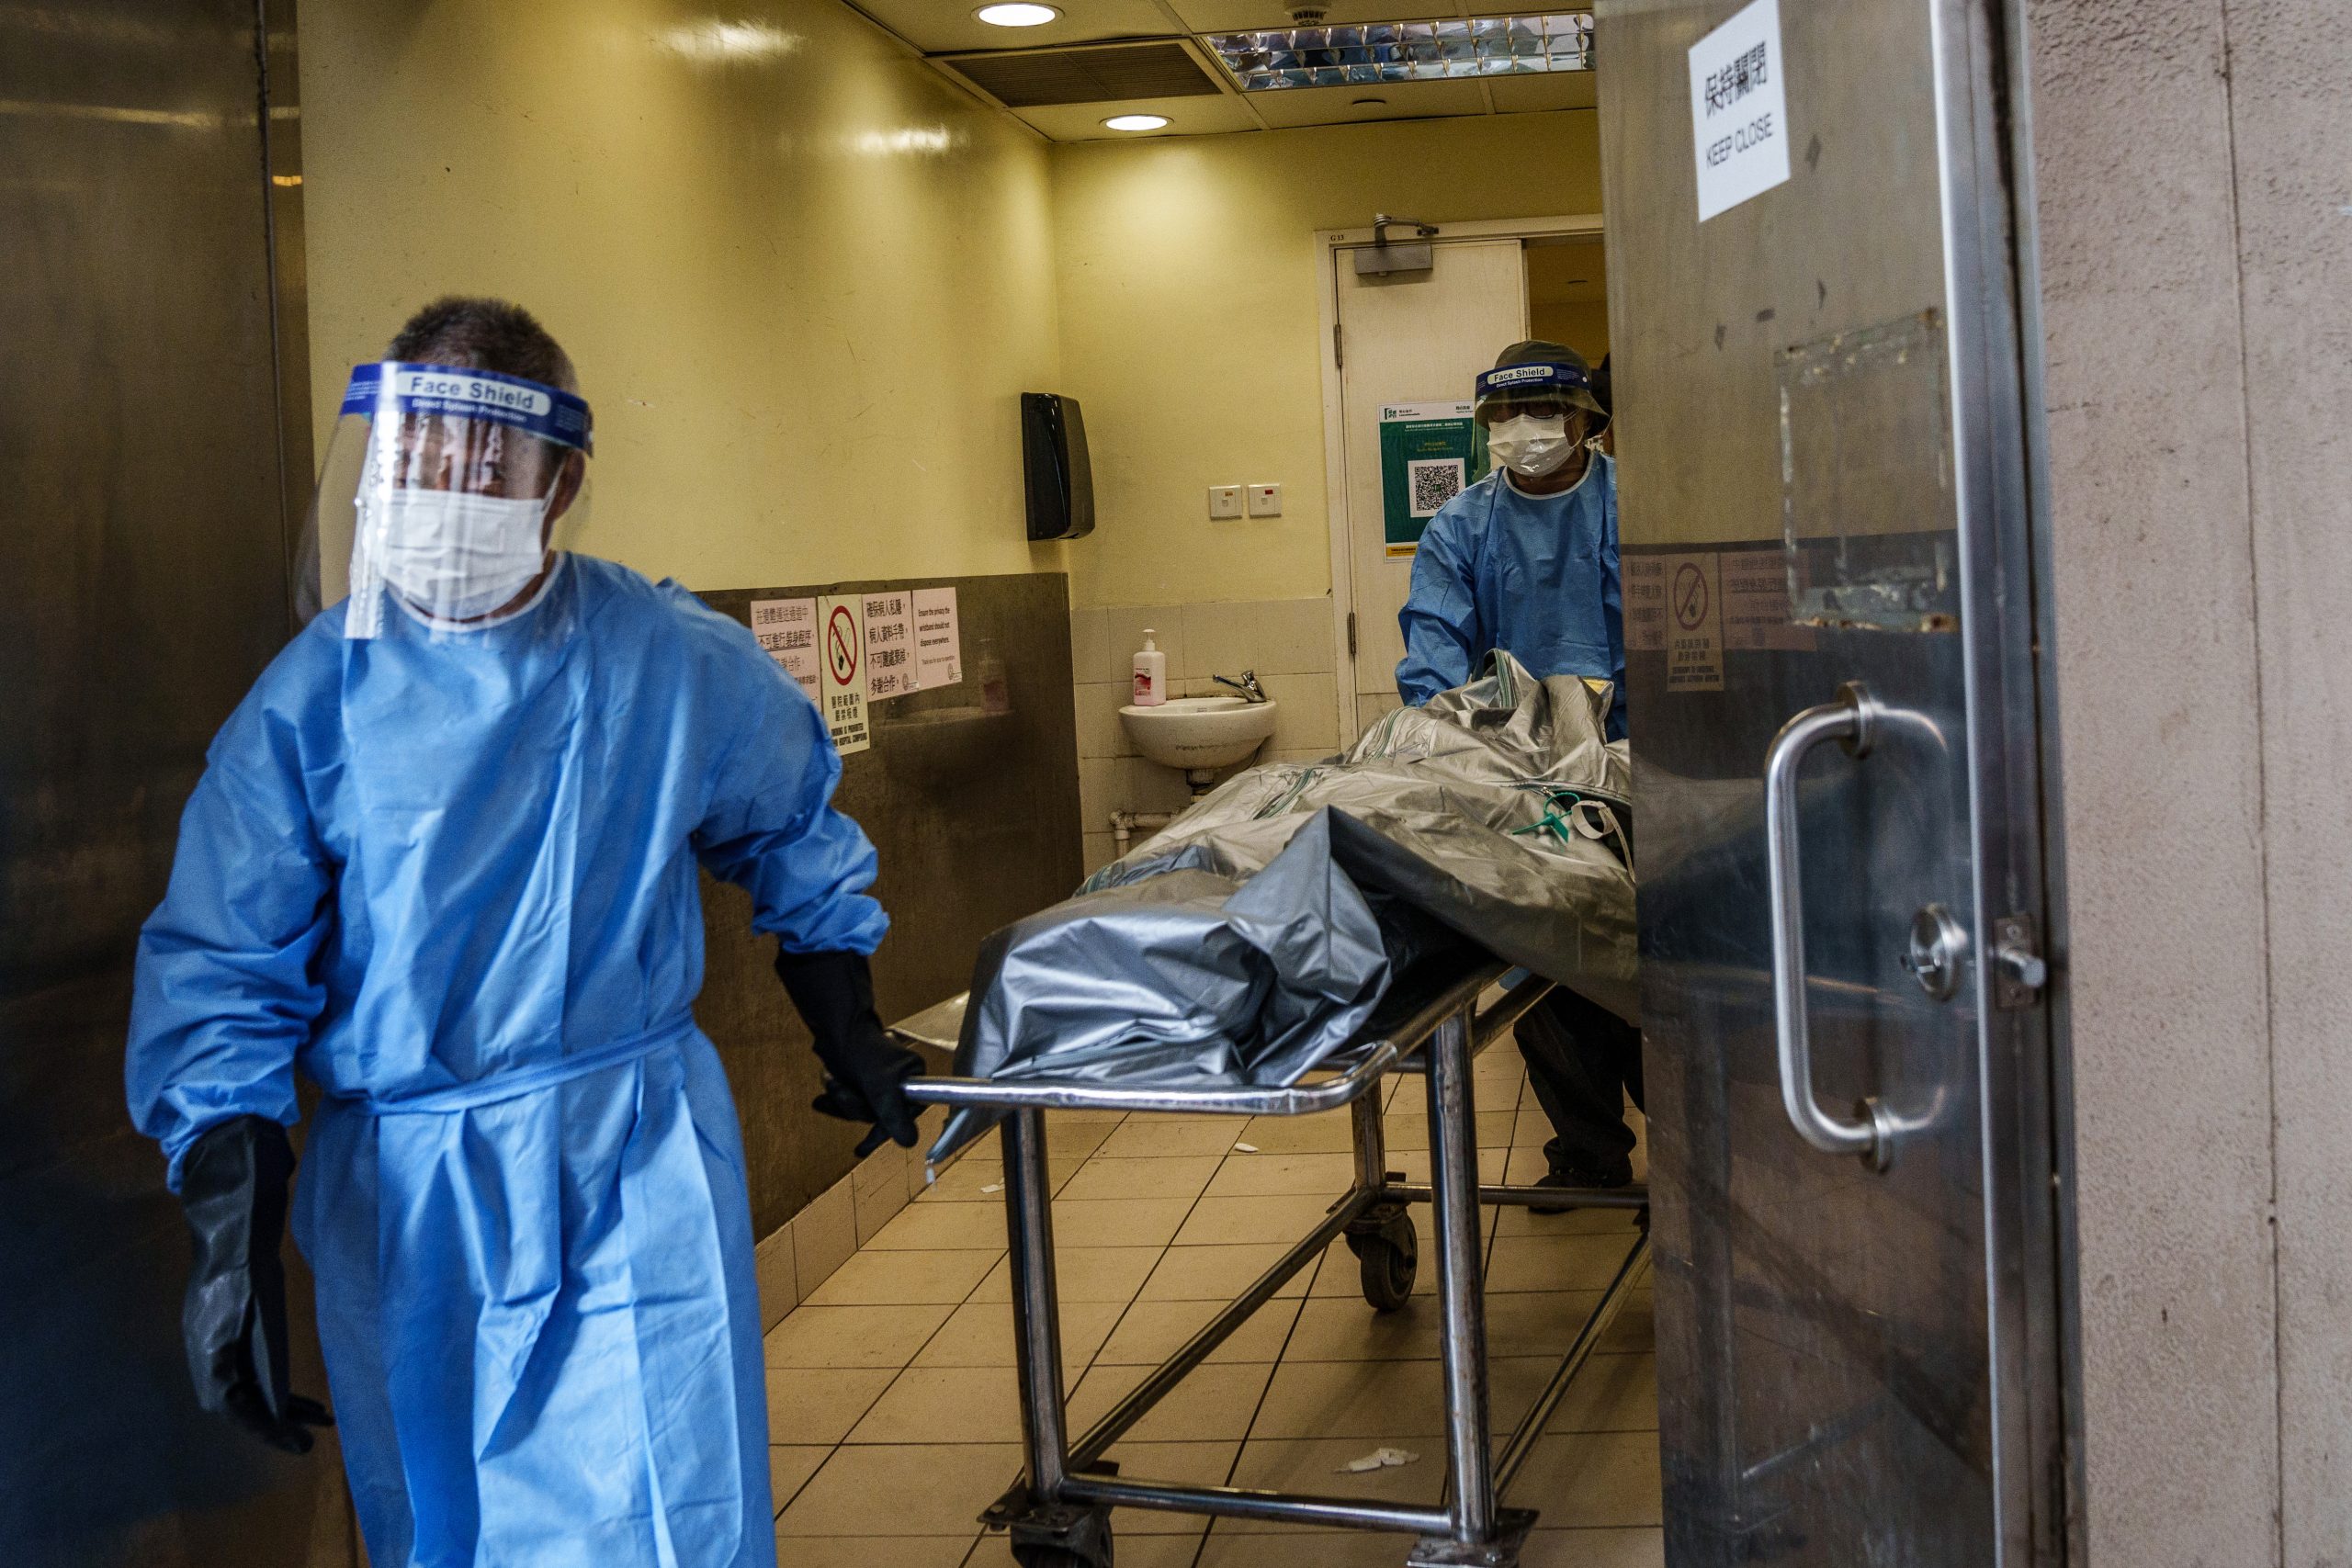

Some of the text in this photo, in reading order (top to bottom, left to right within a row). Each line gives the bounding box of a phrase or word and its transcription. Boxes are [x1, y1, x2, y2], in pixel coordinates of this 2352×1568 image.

[1707, 112, 1772, 169] KEEP CLOSE
[1494, 368, 1545, 381] Face Shield
[411, 377, 534, 410] Face Shield
